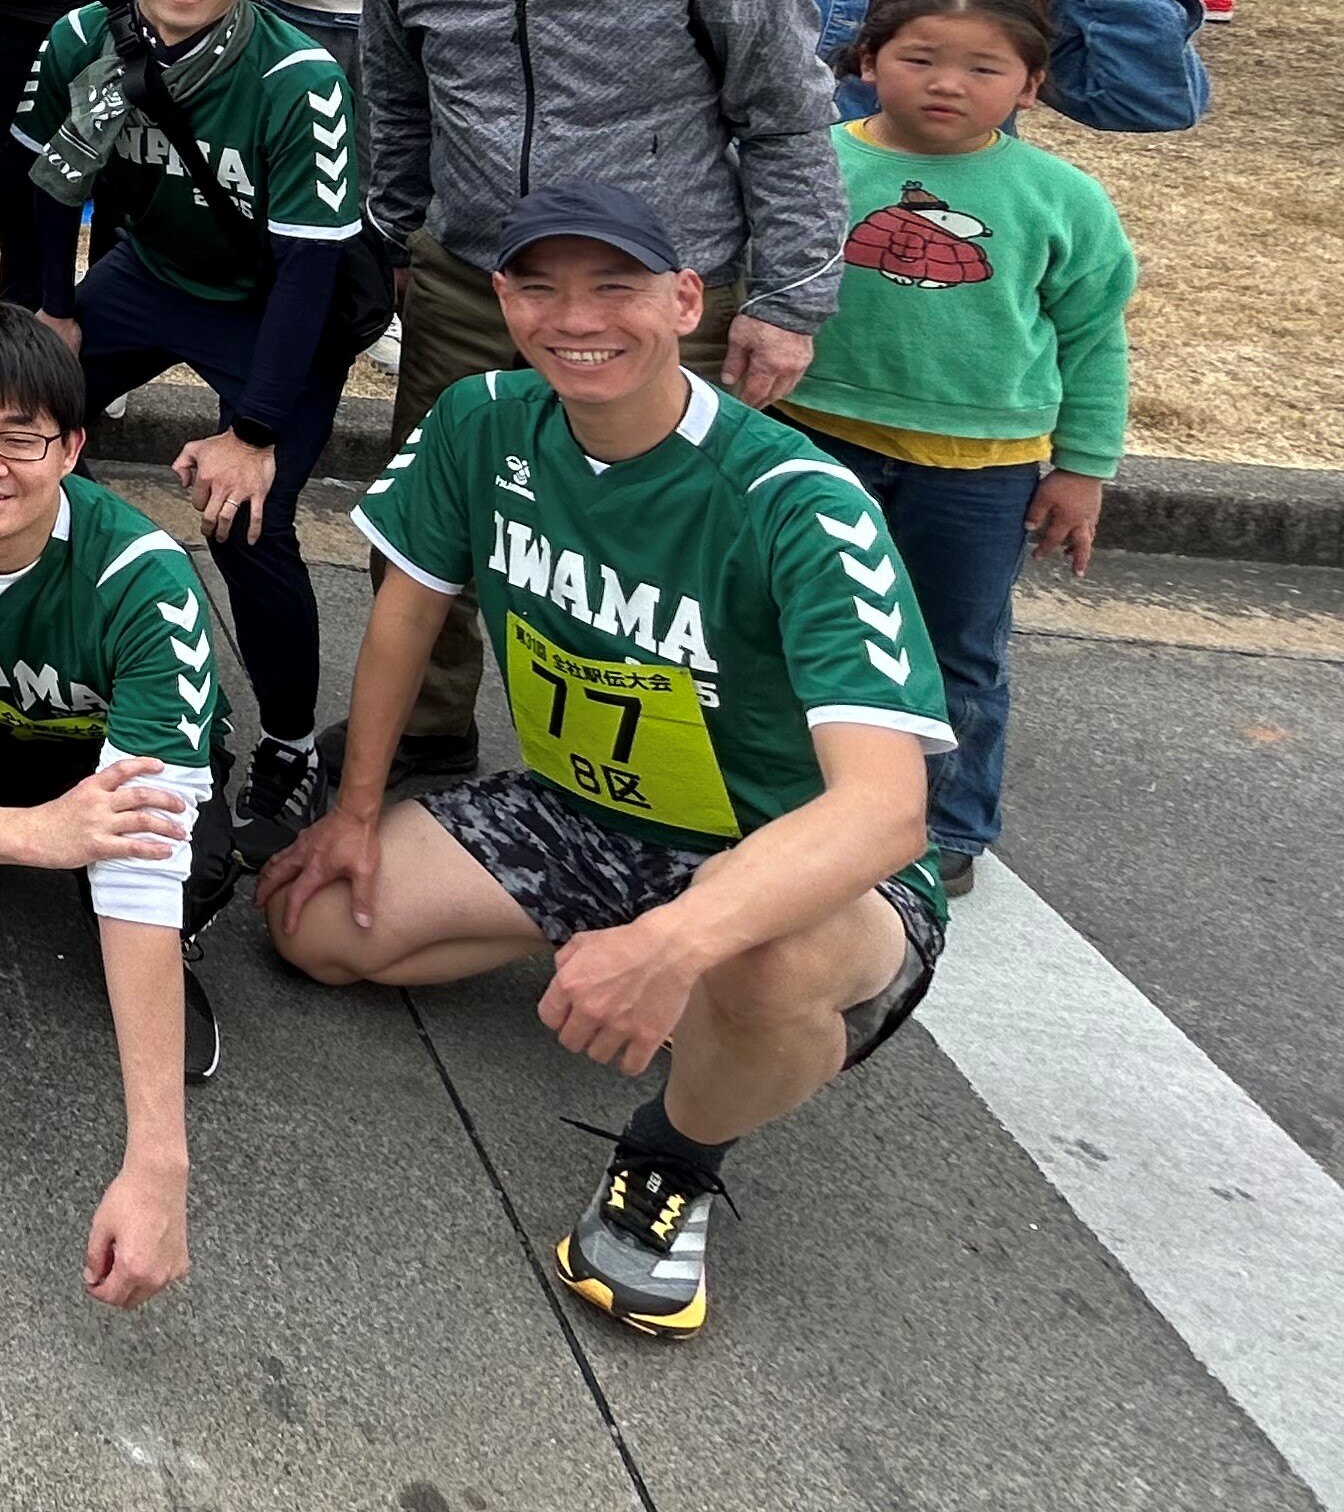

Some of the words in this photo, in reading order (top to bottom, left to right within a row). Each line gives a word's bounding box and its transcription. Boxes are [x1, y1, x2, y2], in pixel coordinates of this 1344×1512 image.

[488, 510, 720, 674] IWAMA
[530, 659, 643, 764] 77
[551, 653, 673, 693] 全社駅伝大会
[569, 752, 653, 811] 8区
